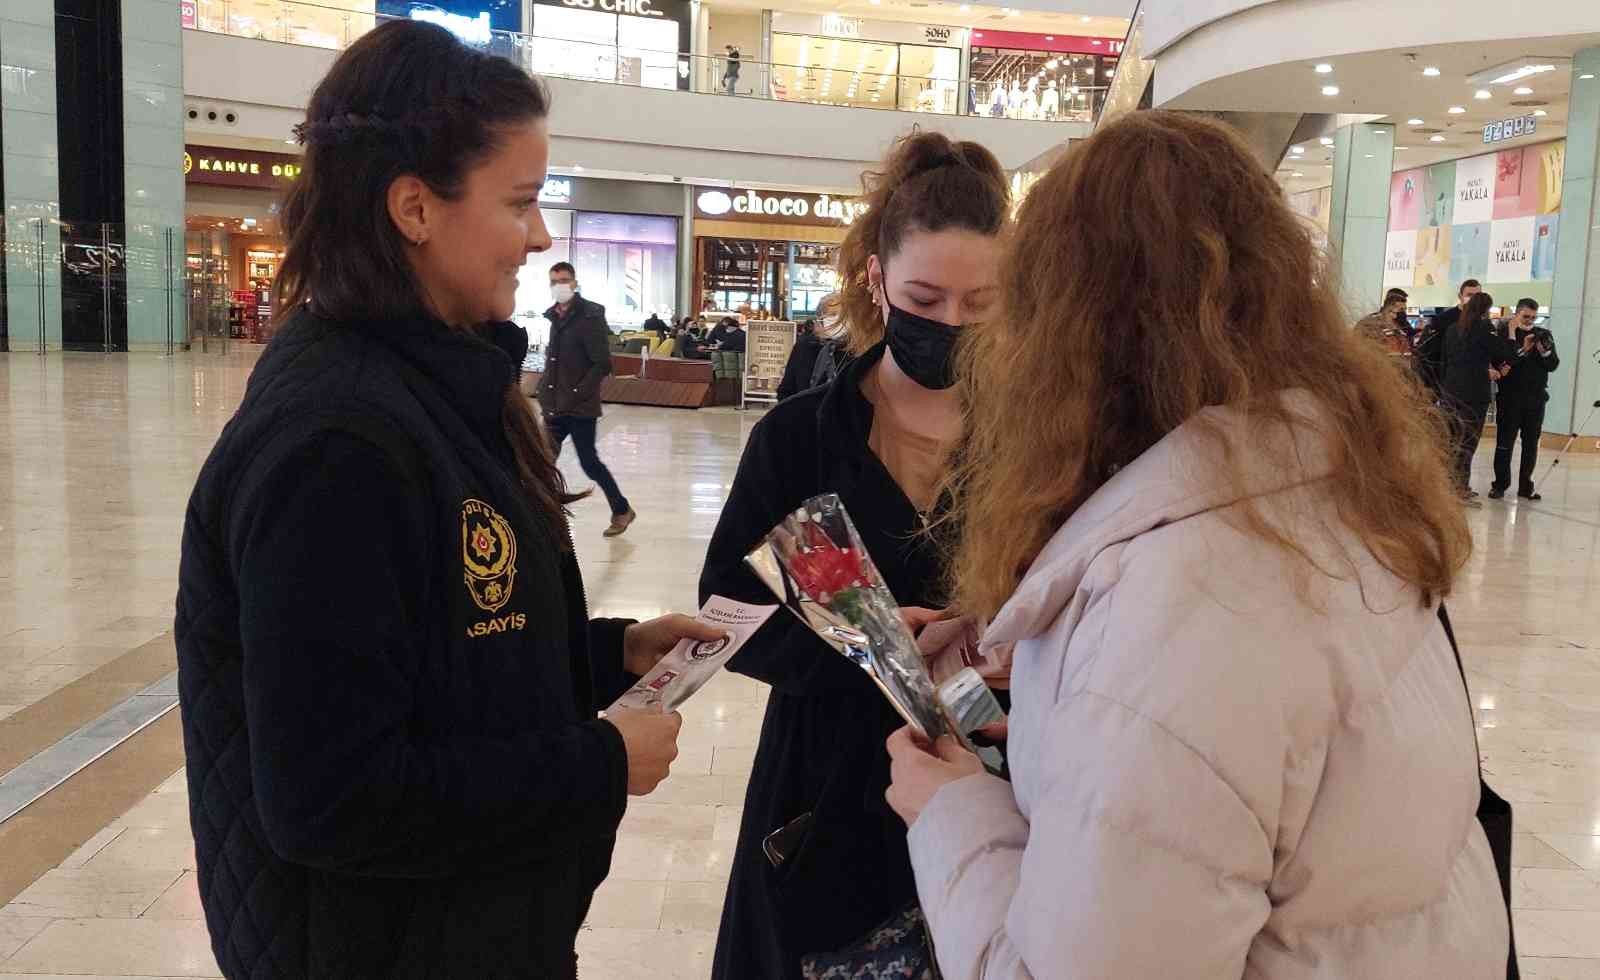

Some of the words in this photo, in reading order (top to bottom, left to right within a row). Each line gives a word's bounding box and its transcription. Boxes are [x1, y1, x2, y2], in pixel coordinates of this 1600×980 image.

[199, 159, 259, 174] KAHVE
[1460, 188, 1489, 201] YAKALA
[733, 190, 809, 217] choco
[1495, 249, 1526, 264] YAKALA
